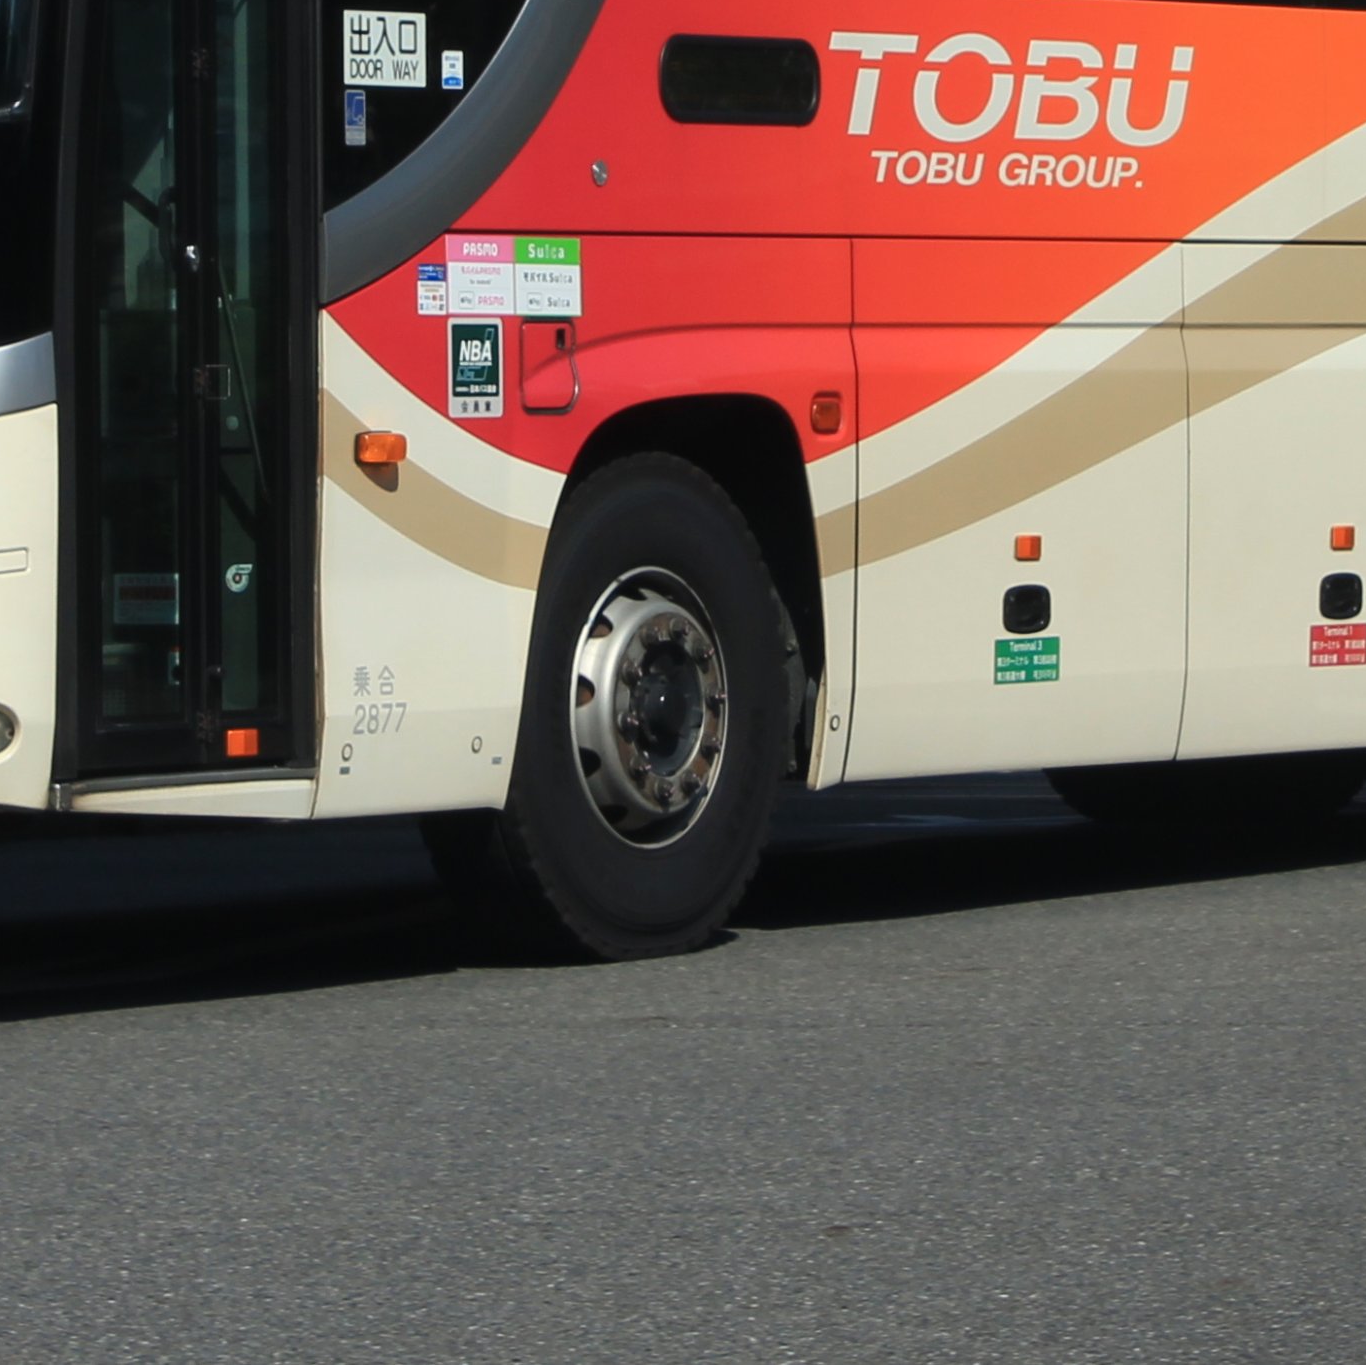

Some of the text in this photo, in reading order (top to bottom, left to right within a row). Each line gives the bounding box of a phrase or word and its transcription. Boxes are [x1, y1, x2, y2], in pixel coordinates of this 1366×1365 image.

[349, 14, 417, 56] 出入口
[349, 57, 419, 81] DOOR WAY
[828, 31, 1195, 146] TOBU
[870, 150, 1143, 189] TOBU GROUP.
[462, 242, 499, 257] PASMO
[527, 243, 566, 259] Suica
[459, 339, 493, 362] NBA
[353, 665, 395, 697] 乗合
[352, 702, 408, 735] 2877
